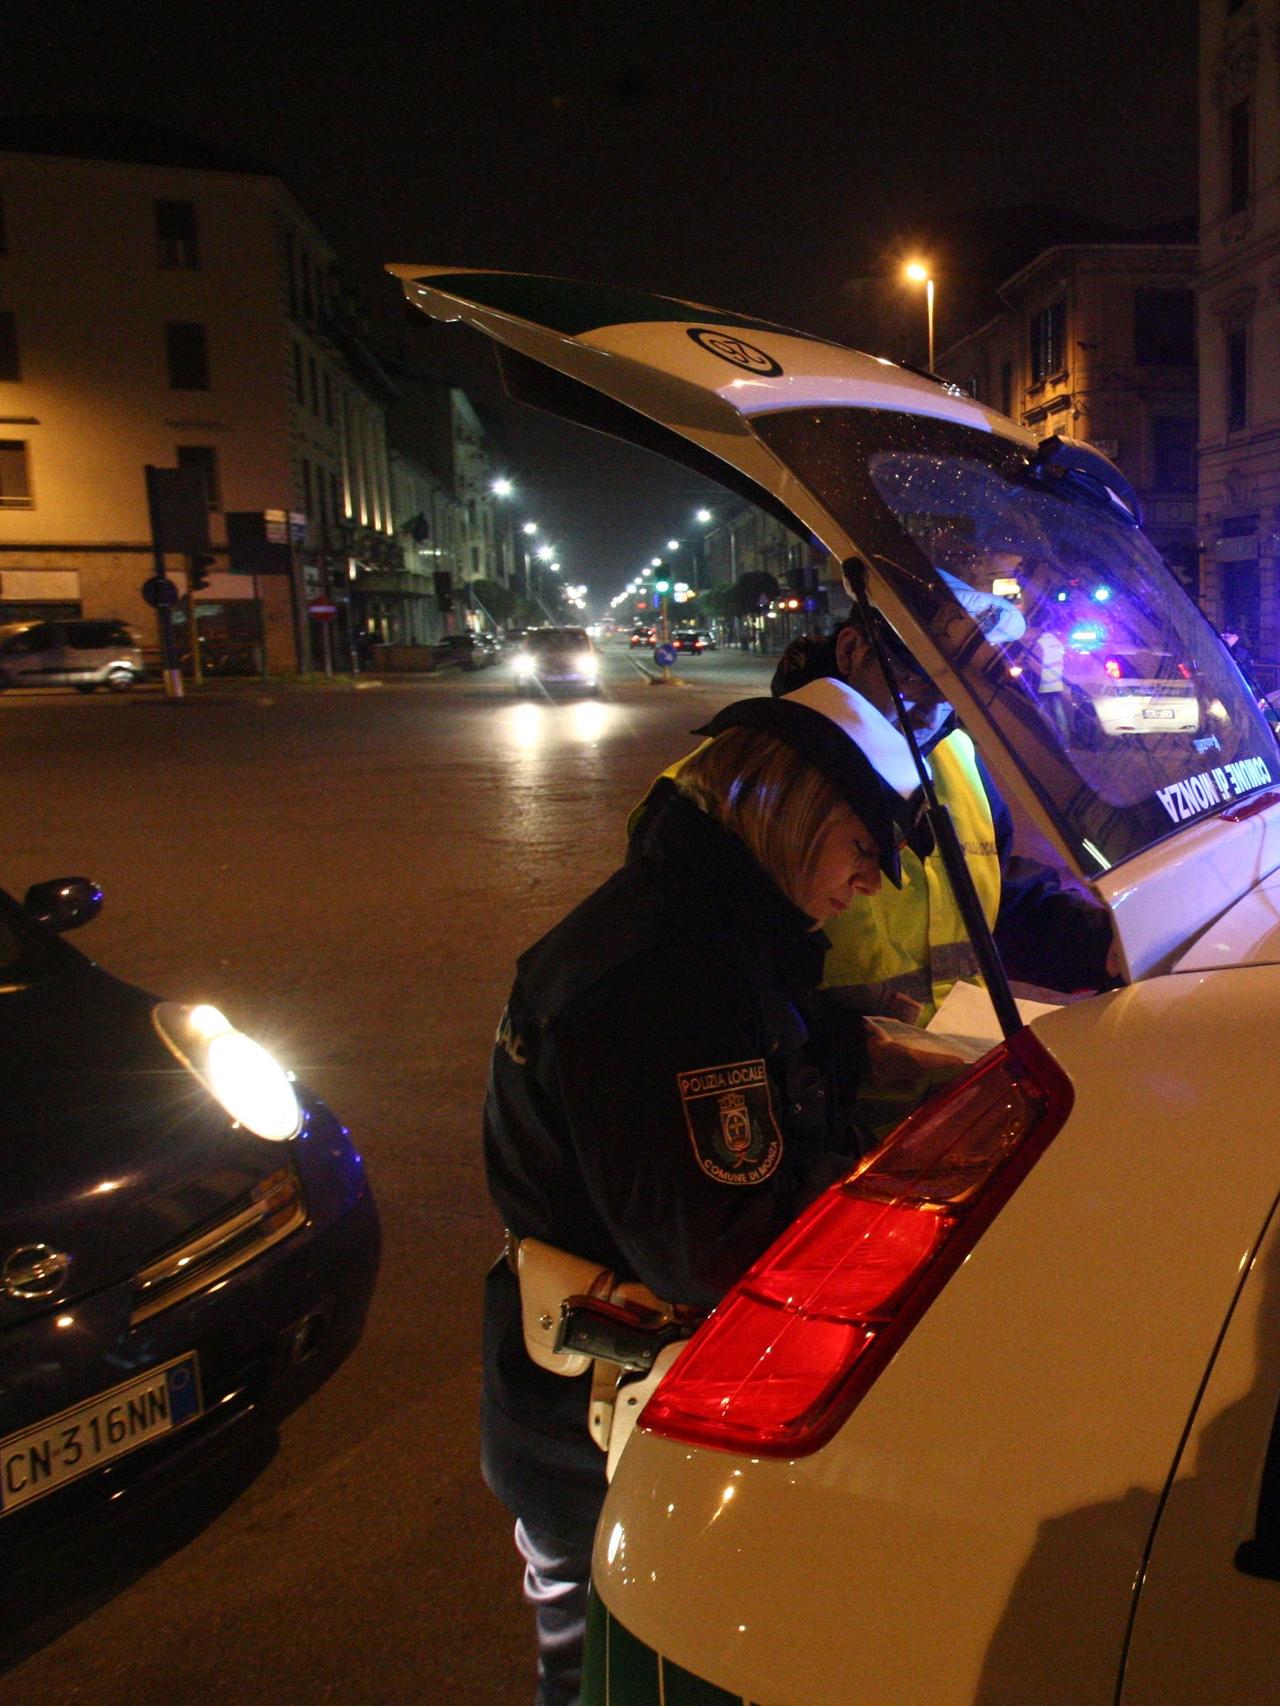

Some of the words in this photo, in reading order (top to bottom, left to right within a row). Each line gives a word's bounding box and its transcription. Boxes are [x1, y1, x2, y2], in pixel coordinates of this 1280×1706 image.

[708, 338, 767, 364] 26
[1211, 767, 1232, 801] di
[1224, 756, 1272, 795] COMUNE
[1155, 771, 1221, 824] MONZA
[681, 1073, 727, 1096] POLIZIA
[728, 1065, 765, 1086] LOCALE
[703, 1159, 748, 1183] COMUNE
[749, 1172, 761, 1182] DI
[759, 1140, 779, 1176] MONZA
